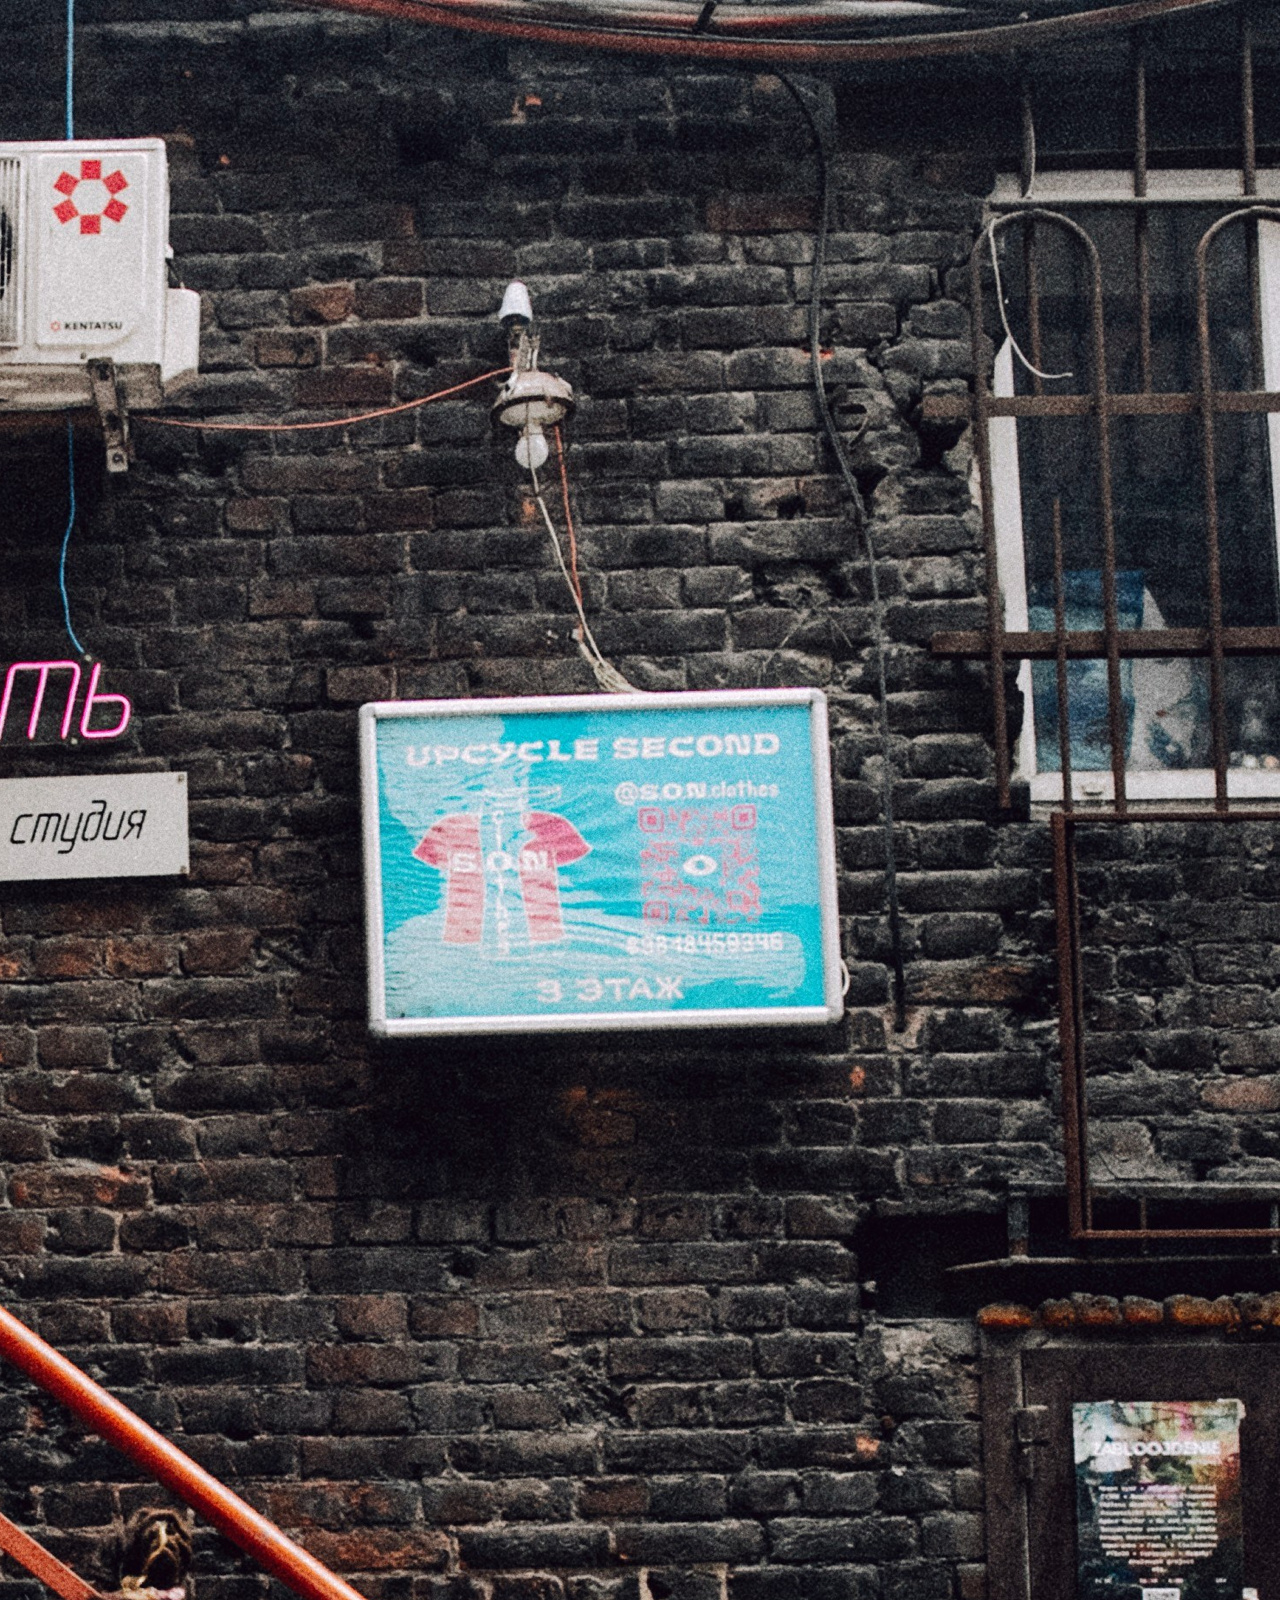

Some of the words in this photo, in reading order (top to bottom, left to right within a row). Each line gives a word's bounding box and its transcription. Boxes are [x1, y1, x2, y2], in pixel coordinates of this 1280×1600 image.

[63, 320, 123, 331] KENTATSU
[406, 738, 600, 767] UPCYCLE
[612, 733, 781, 760] SECOND
[10, 799, 148, 856] студия
[536, 980, 562, 1002] 3
[576, 974, 685, 1001] ЭТАЖ
